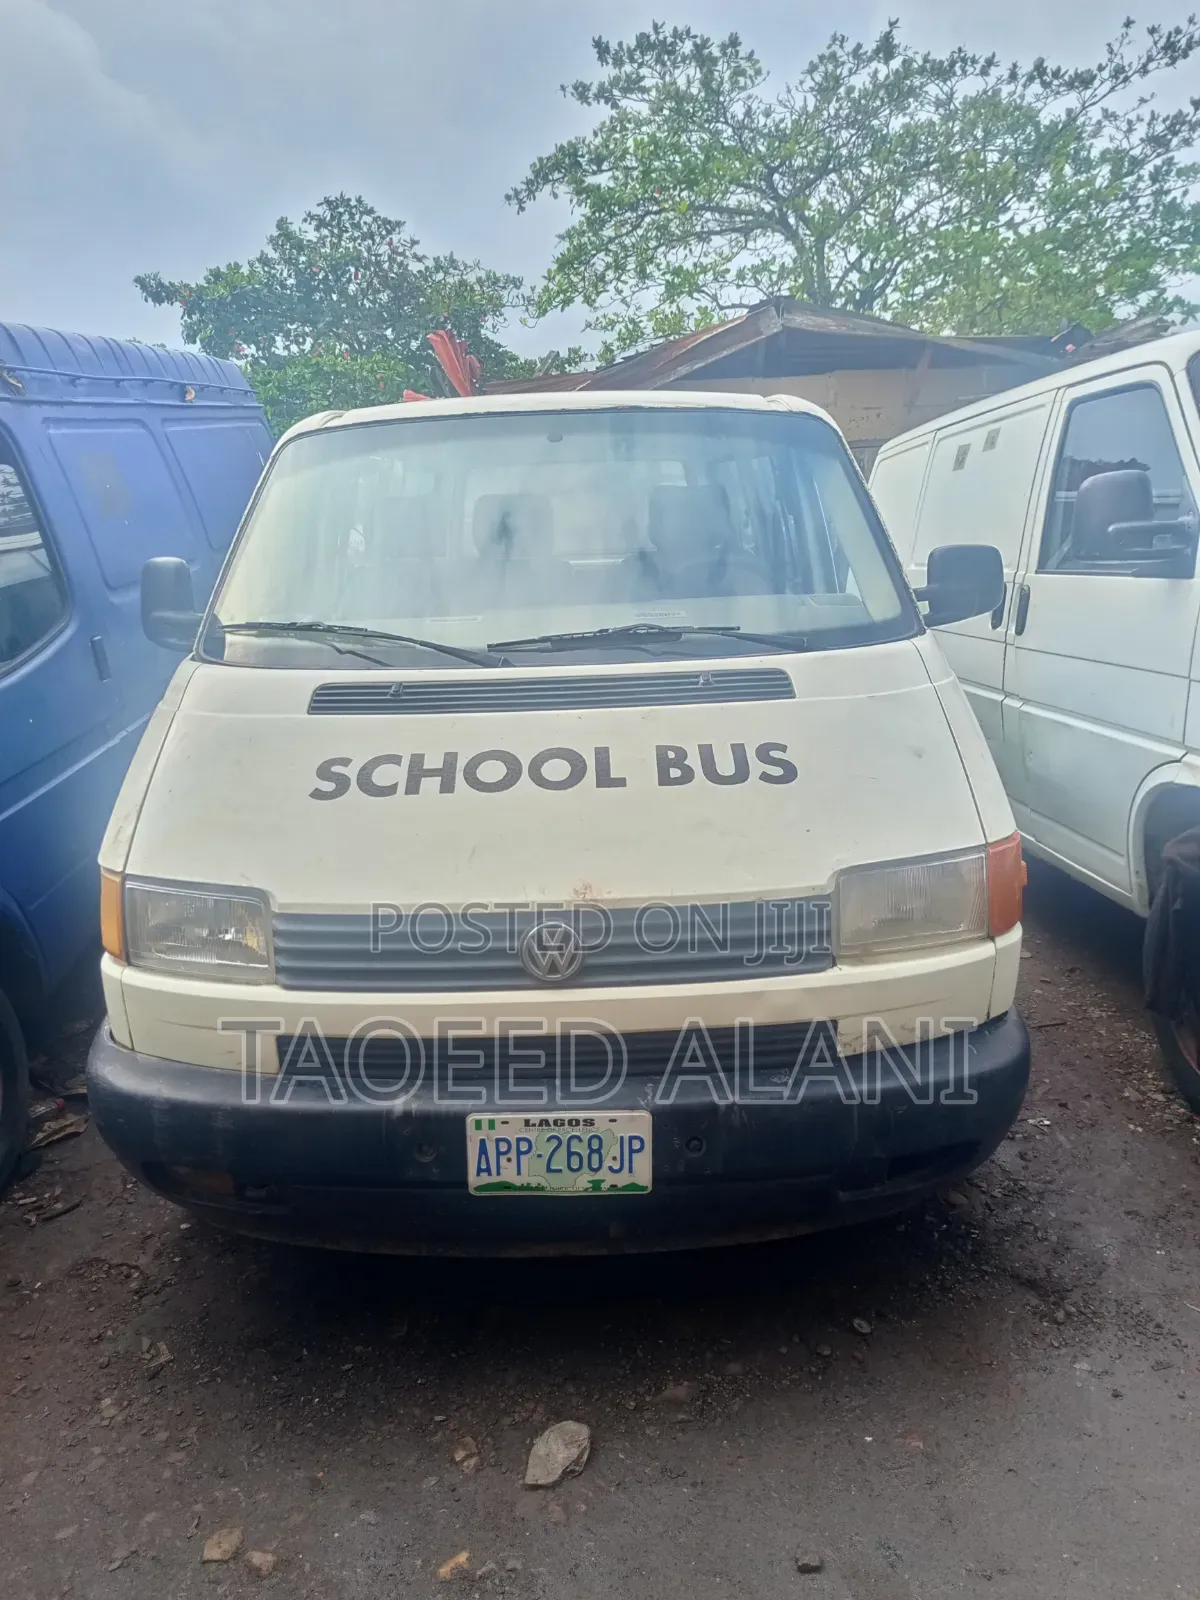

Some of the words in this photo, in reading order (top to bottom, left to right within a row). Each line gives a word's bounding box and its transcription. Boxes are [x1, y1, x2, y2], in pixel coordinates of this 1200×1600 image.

[308, 747, 628, 801] SCHOOL
[655, 742, 799, 787] BUS
[523, 921, 582, 981] VW
[523, 1118, 596, 1128] LAGOS
